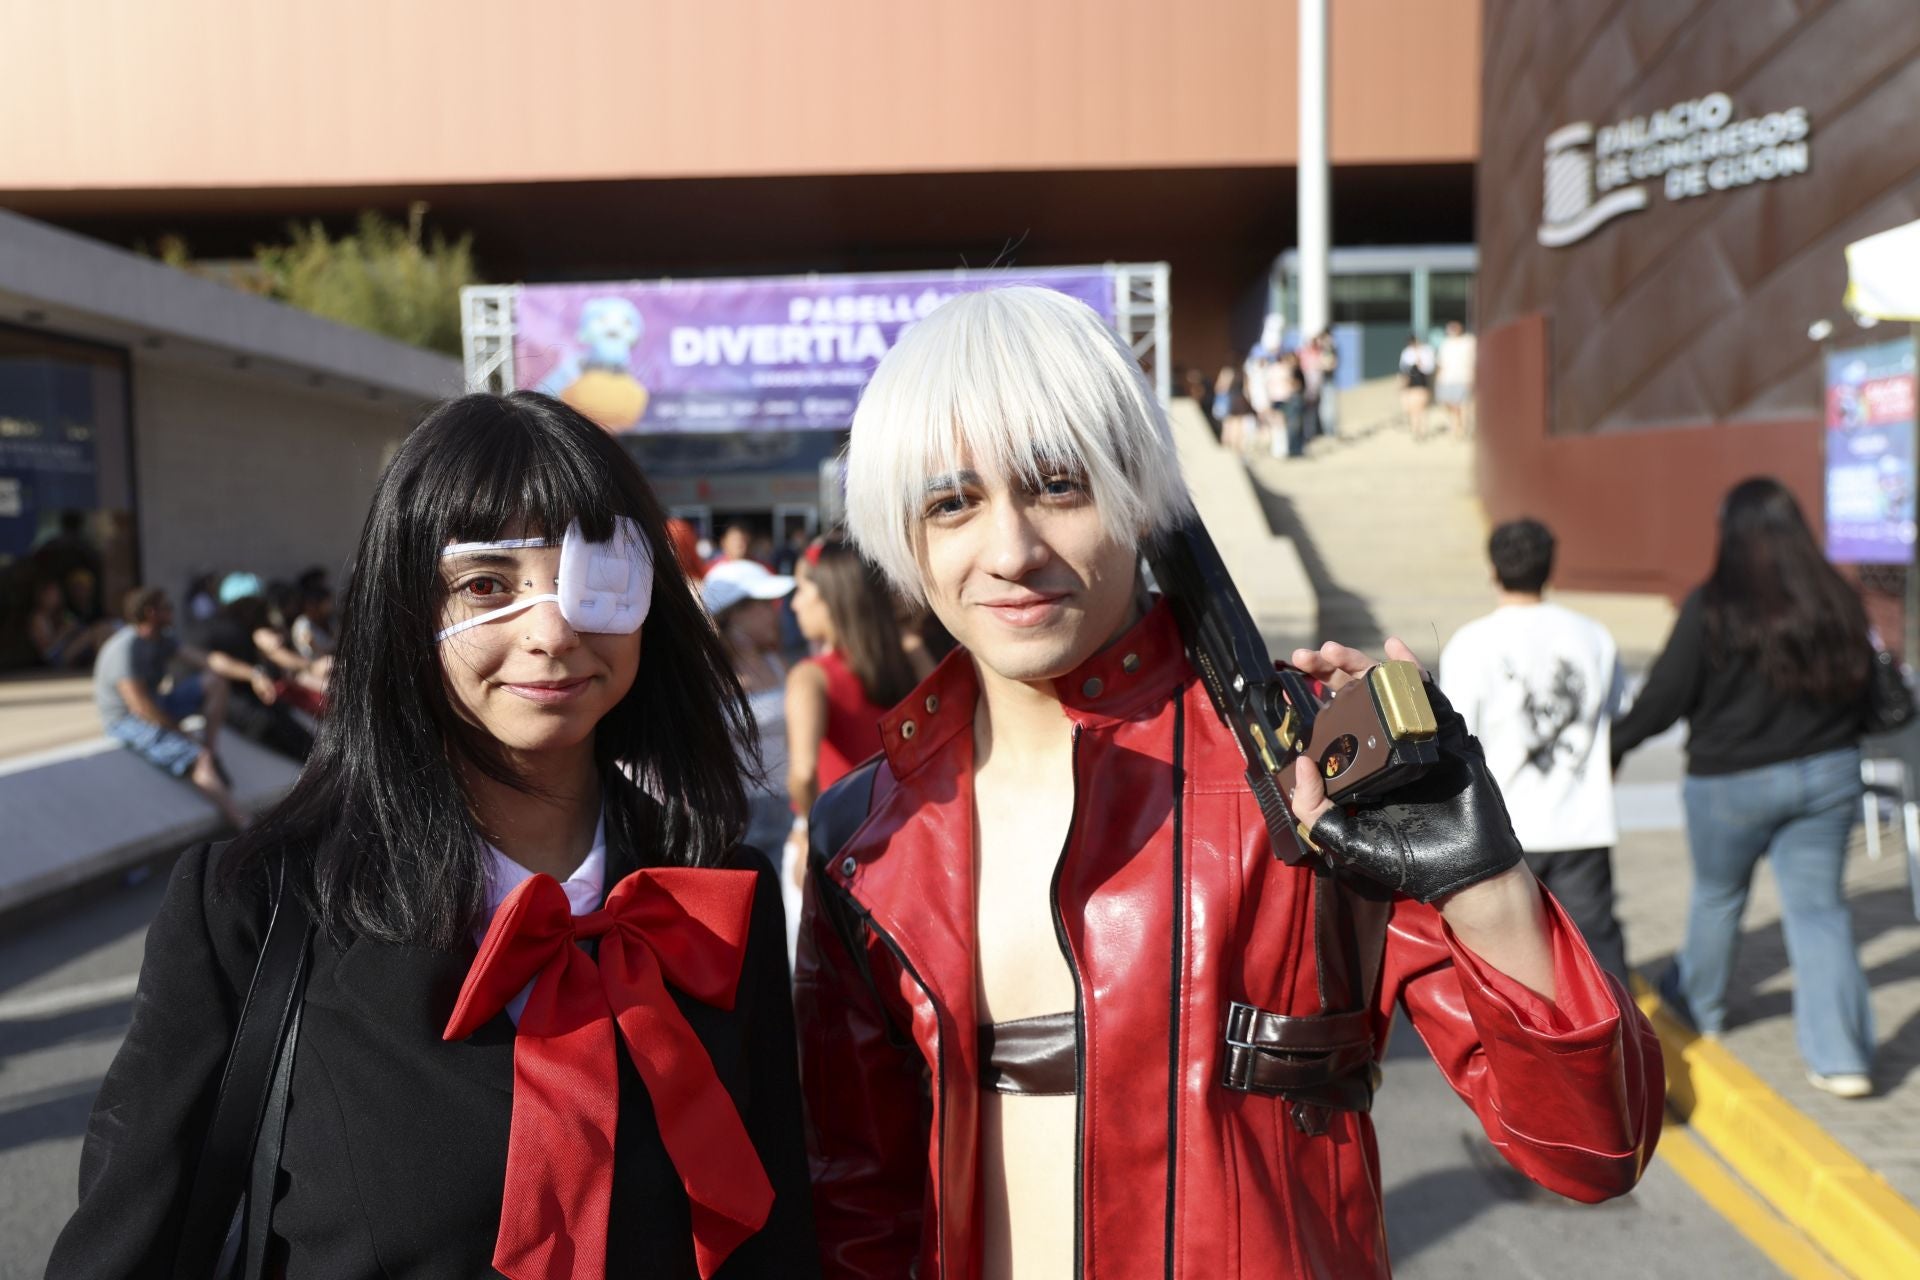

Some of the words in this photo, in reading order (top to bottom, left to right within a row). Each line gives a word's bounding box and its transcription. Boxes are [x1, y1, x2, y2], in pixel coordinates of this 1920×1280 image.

[1596, 92, 1732, 159] PALACIO
[1596, 154, 1629, 191] DE
[1628, 106, 1809, 179] CONGRESOS
[1664, 163, 1706, 200] DE
[670, 323, 888, 366] DIVERTIA
